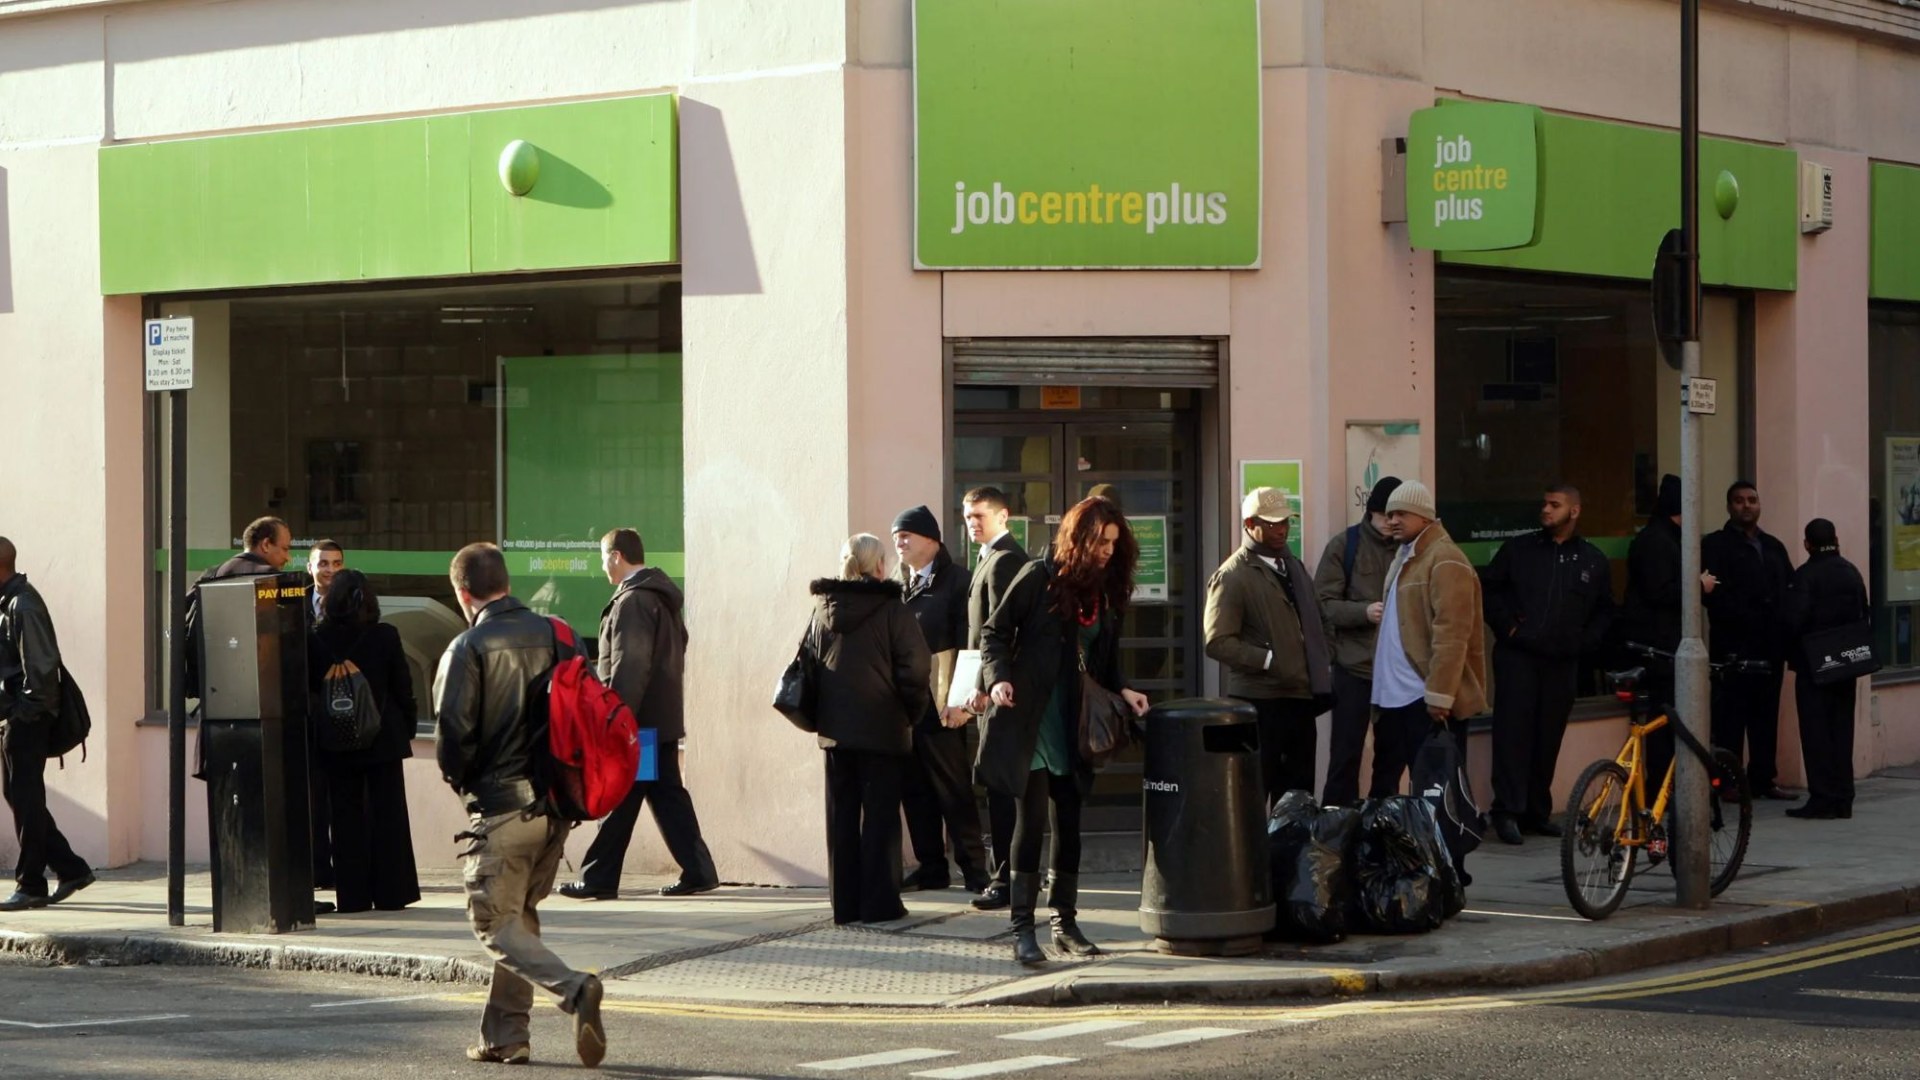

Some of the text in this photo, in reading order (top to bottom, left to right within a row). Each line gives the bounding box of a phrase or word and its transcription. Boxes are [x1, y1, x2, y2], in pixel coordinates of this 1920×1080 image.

[1434, 135, 1472, 168] job
[1433, 164, 1508, 192] centre
[951, 181, 1228, 234] jobcentreplus
[1434, 193, 1483, 227] plus
[151, 325, 161, 344] P
[529, 556, 588, 572] jobcentreplus
[258, 587, 306, 599] PAY HERE
